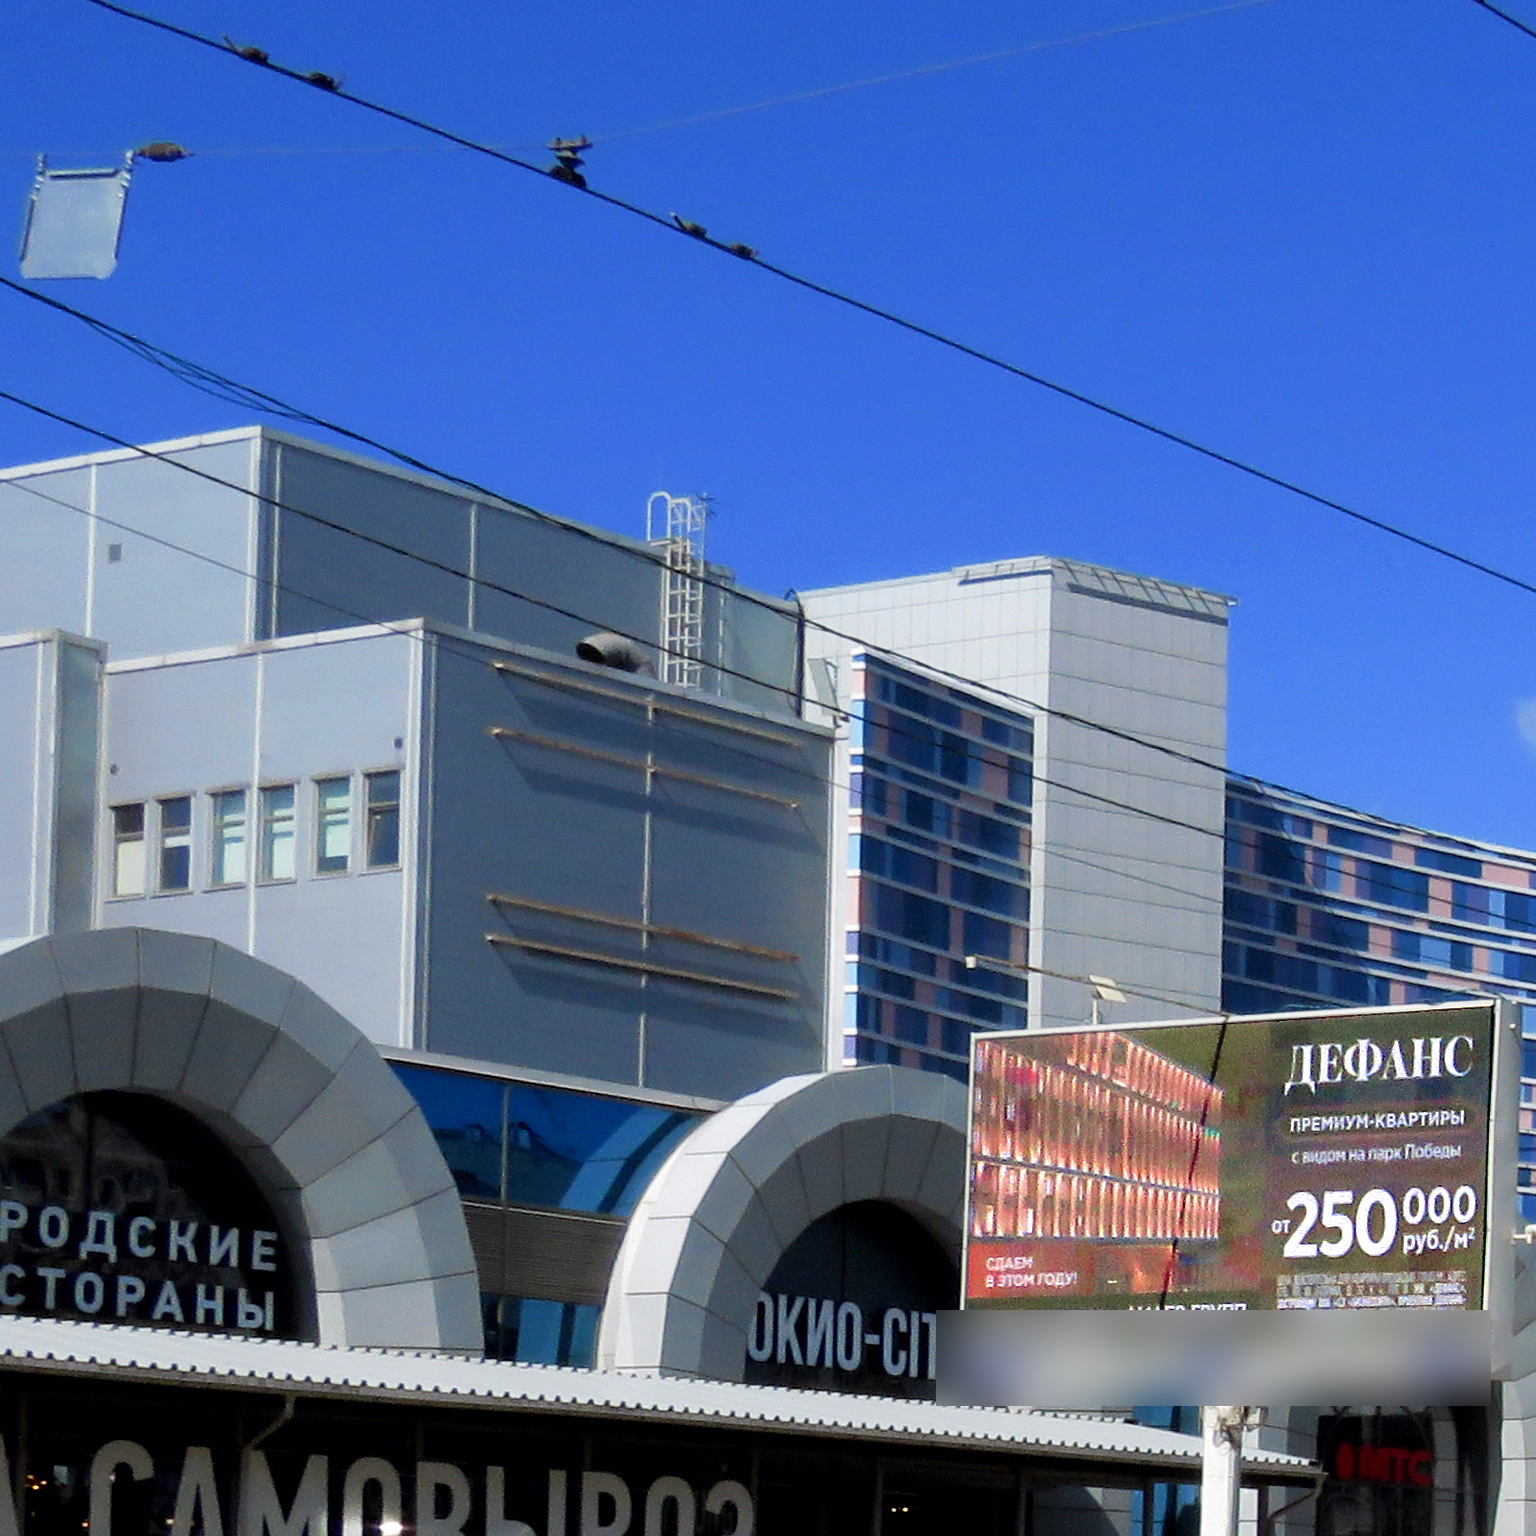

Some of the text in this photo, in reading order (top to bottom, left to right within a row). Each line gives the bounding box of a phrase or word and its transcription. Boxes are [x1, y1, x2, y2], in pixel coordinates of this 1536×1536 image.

[1284, 1035, 1474, 1096] ДЕФАНС
[1290, 1110, 1465, 1133] ПРЕМИУМ-КВАРТИРЫ
[1302, 1150, 1346, 1166] видом
[1348, 1149, 1366, 1162] на
[1368, 1147, 1402, 1163] парк
[1404, 1143, 1462, 1160] Победы
[0, 1200, 279, 1272] РОДСКИЕ
[1271, 1185, 1477, 1258] от 250 000
[985, 1256, 1034, 1271] СДАЕМ
[985, 1270, 1078, 1289] В ЭТОМ ГОДУ!
[0, 1263, 276, 1332] СТОРАНЫ
[1359, 1445, 1432, 1486] МТС
